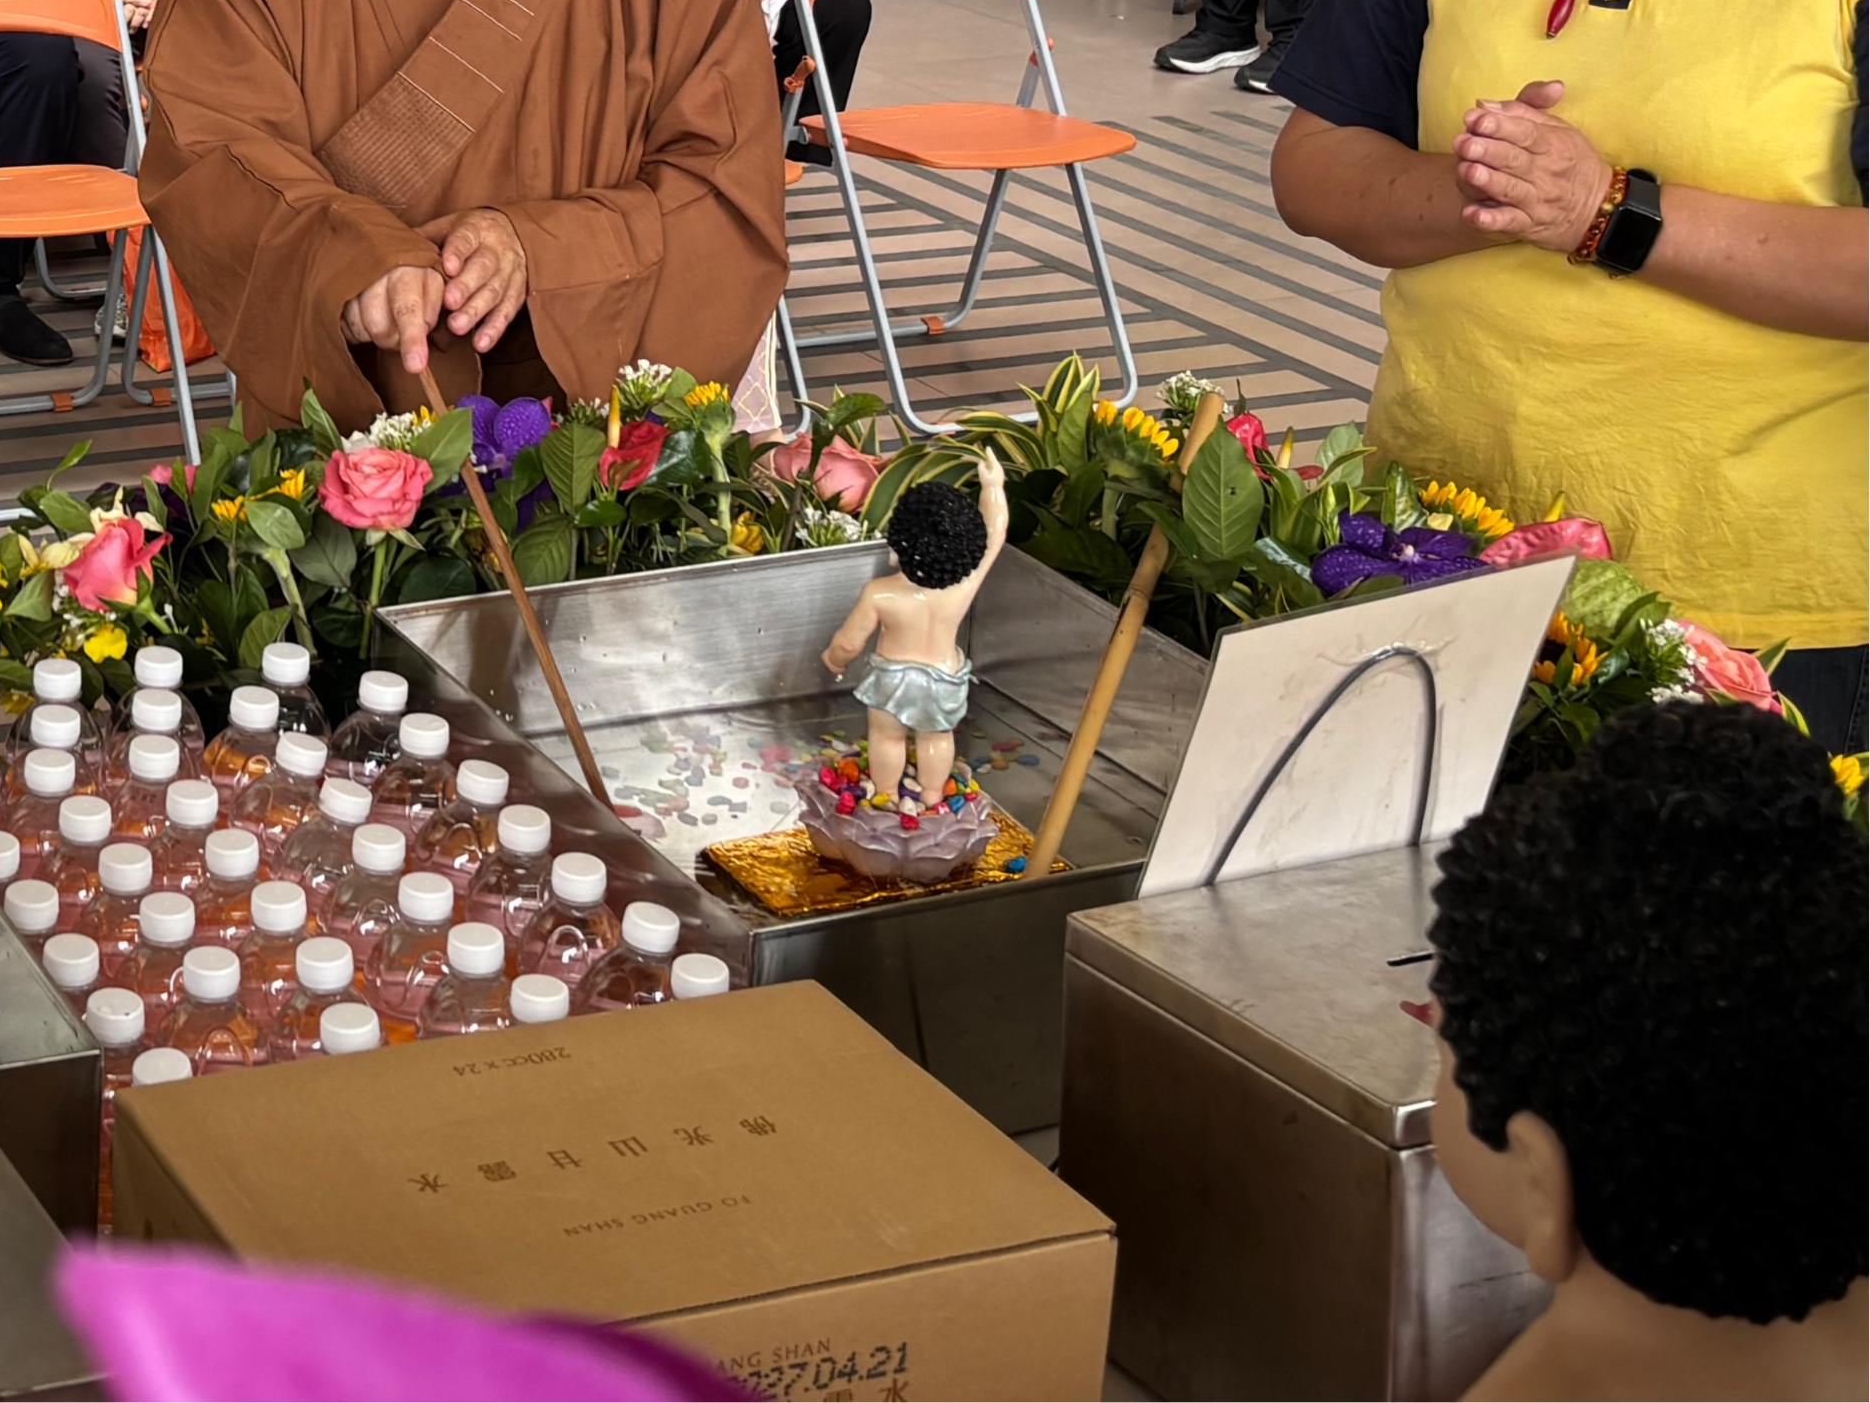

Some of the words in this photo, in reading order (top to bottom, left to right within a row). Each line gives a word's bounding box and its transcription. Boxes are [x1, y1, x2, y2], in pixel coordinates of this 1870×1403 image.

[452, 1062, 482, 1077] 24
[408, 1115, 778, 1195] 佛光山甘露水
[720, 1194, 752, 1208] FO
[630, 1201, 713, 1226] GUANG
[562, 1216, 625, 1238] SHAN
[773, 1338, 831, 1364] SHAN
